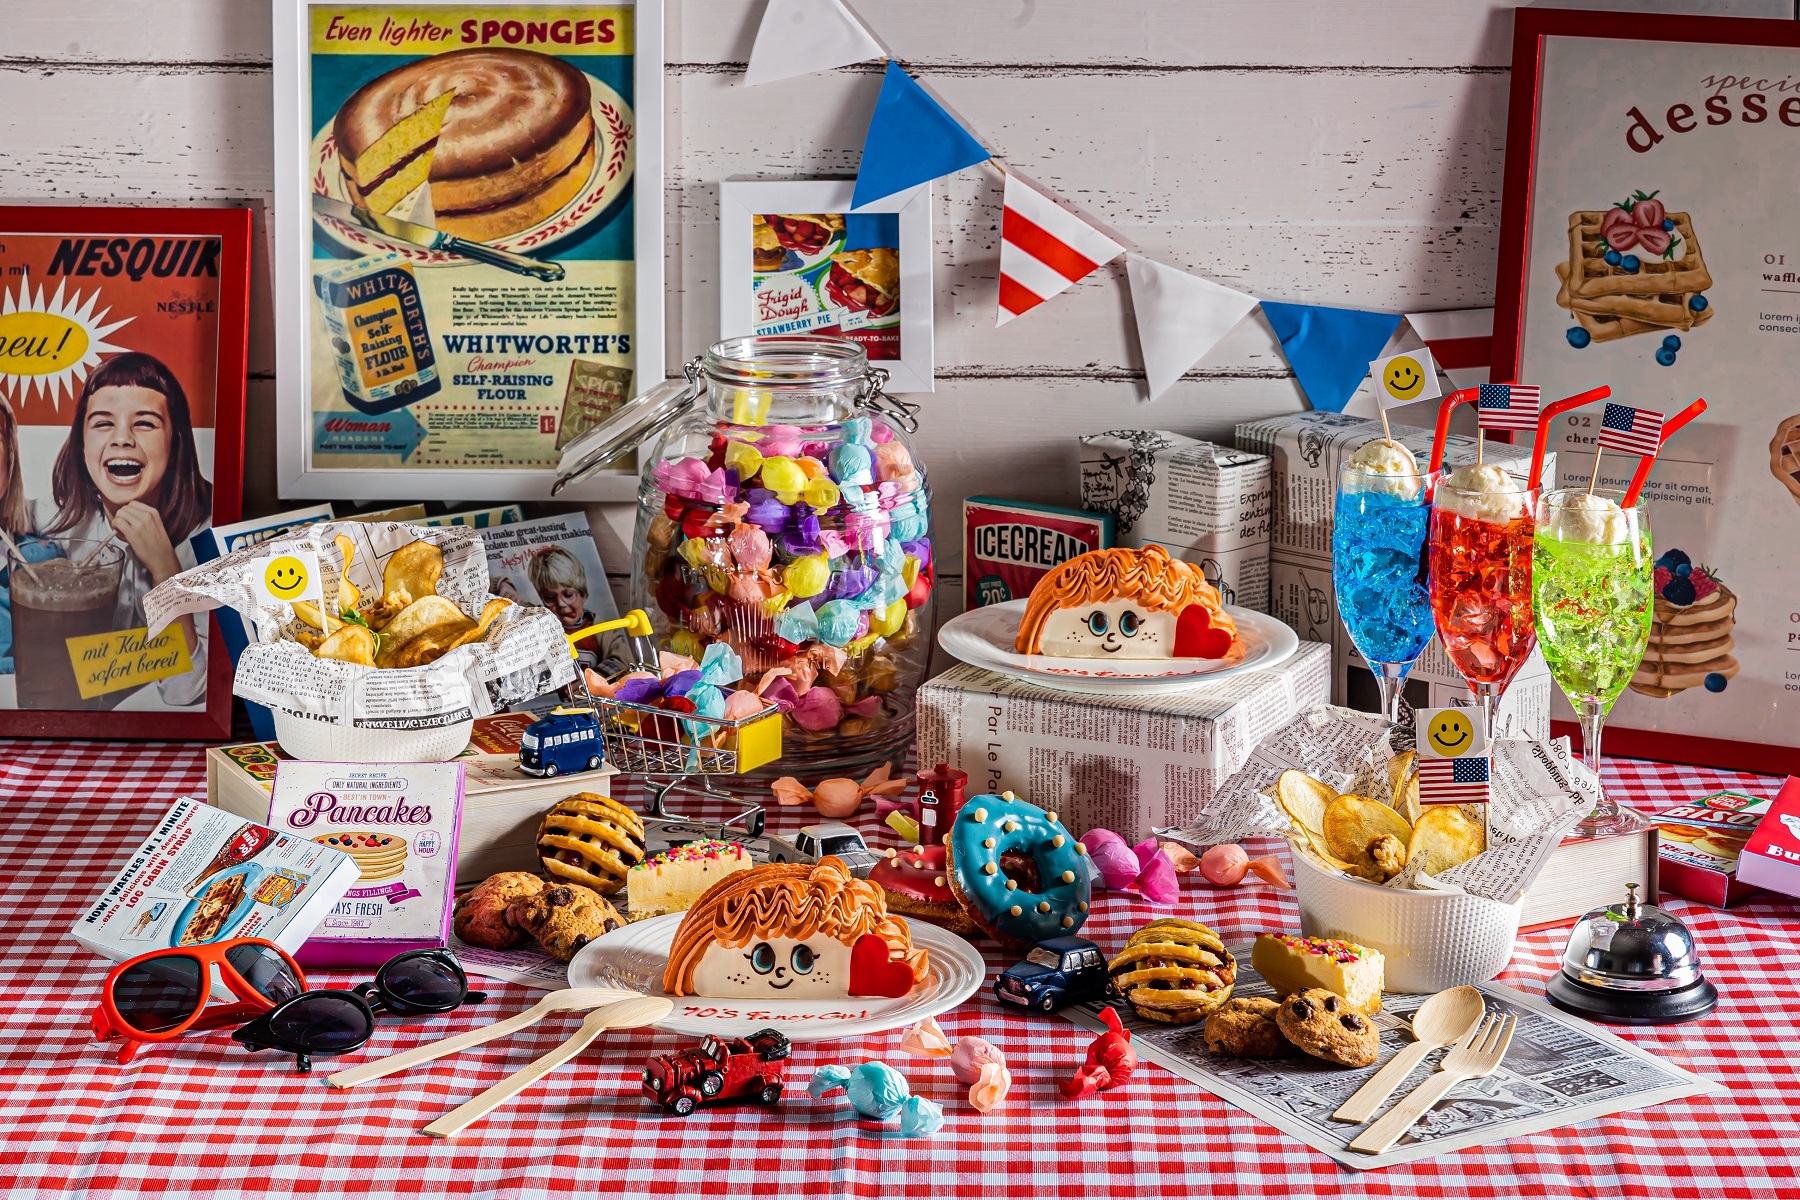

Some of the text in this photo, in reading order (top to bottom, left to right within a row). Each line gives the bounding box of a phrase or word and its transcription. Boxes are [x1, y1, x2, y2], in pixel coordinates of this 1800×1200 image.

[325, 15, 616, 46] Even lighter SPONGES
[1625, 93, 1800, 153] desse
[8, 238, 222, 282] mit NESQUIK
[757, 285, 803, 307] Frigid
[354, 308, 398, 328] Champion
[760, 299, 809, 322] Dough
[1760, 312, 1793, 322] Lorem
[367, 324, 393, 339] Self-
[756, 318, 812, 336] STRAWBERRY
[817, 313, 832, 325] PIE
[361, 334, 402, 353] Raising
[442, 334, 631, 355] WHITWORTH'S
[365, 345, 409, 370] FLOUR
[467, 356, 536, 373] Champion
[452, 374, 554, 386] SELF-RAISING
[477, 388, 527, 400] FLOUR
[324, 417, 392, 433] Woman
[1599, 475, 1630, 486] ipsum
[1644, 480, 1662, 488] olor
[1666, 482, 1677, 490] sit
[1695, 496, 1714, 505] elit.
[485, 528, 592, 551] colate milk without making
[493, 529, 515, 540] make
[516, 522, 566, 537] great-tasting
[976, 525, 1089, 567] ICECREAM
[82, 634, 168, 663] mit Kakao
[88, 650, 179, 686] sofort bereit
[988, 706, 1002, 736] Par
[988, 743, 1002, 762] Le
[346, 781, 368, 789] NATURAL
[369, 780, 402, 789] INGREDIENTS
[287, 792, 433, 829] Pancakes
[418, 840, 435, 848] HAPPY
[1659, 843, 1733, 865] READY
[86, 801, 190, 924] NOW! WAFFLES IN 1 MINUTE
[126, 890, 144, 910] LOG
[142, 859, 169, 888] CABIN
[167, 828, 194, 858] SYRUP
[118, 870, 147, 902] delicious
[146, 852, 160, 868] with
[362, 887, 392, 896] FILLINGS
[355, 903, 382, 916] FRESH
[243, 917, 262, 937] AFFLES
[747, 1010, 816, 1023] Fancy
